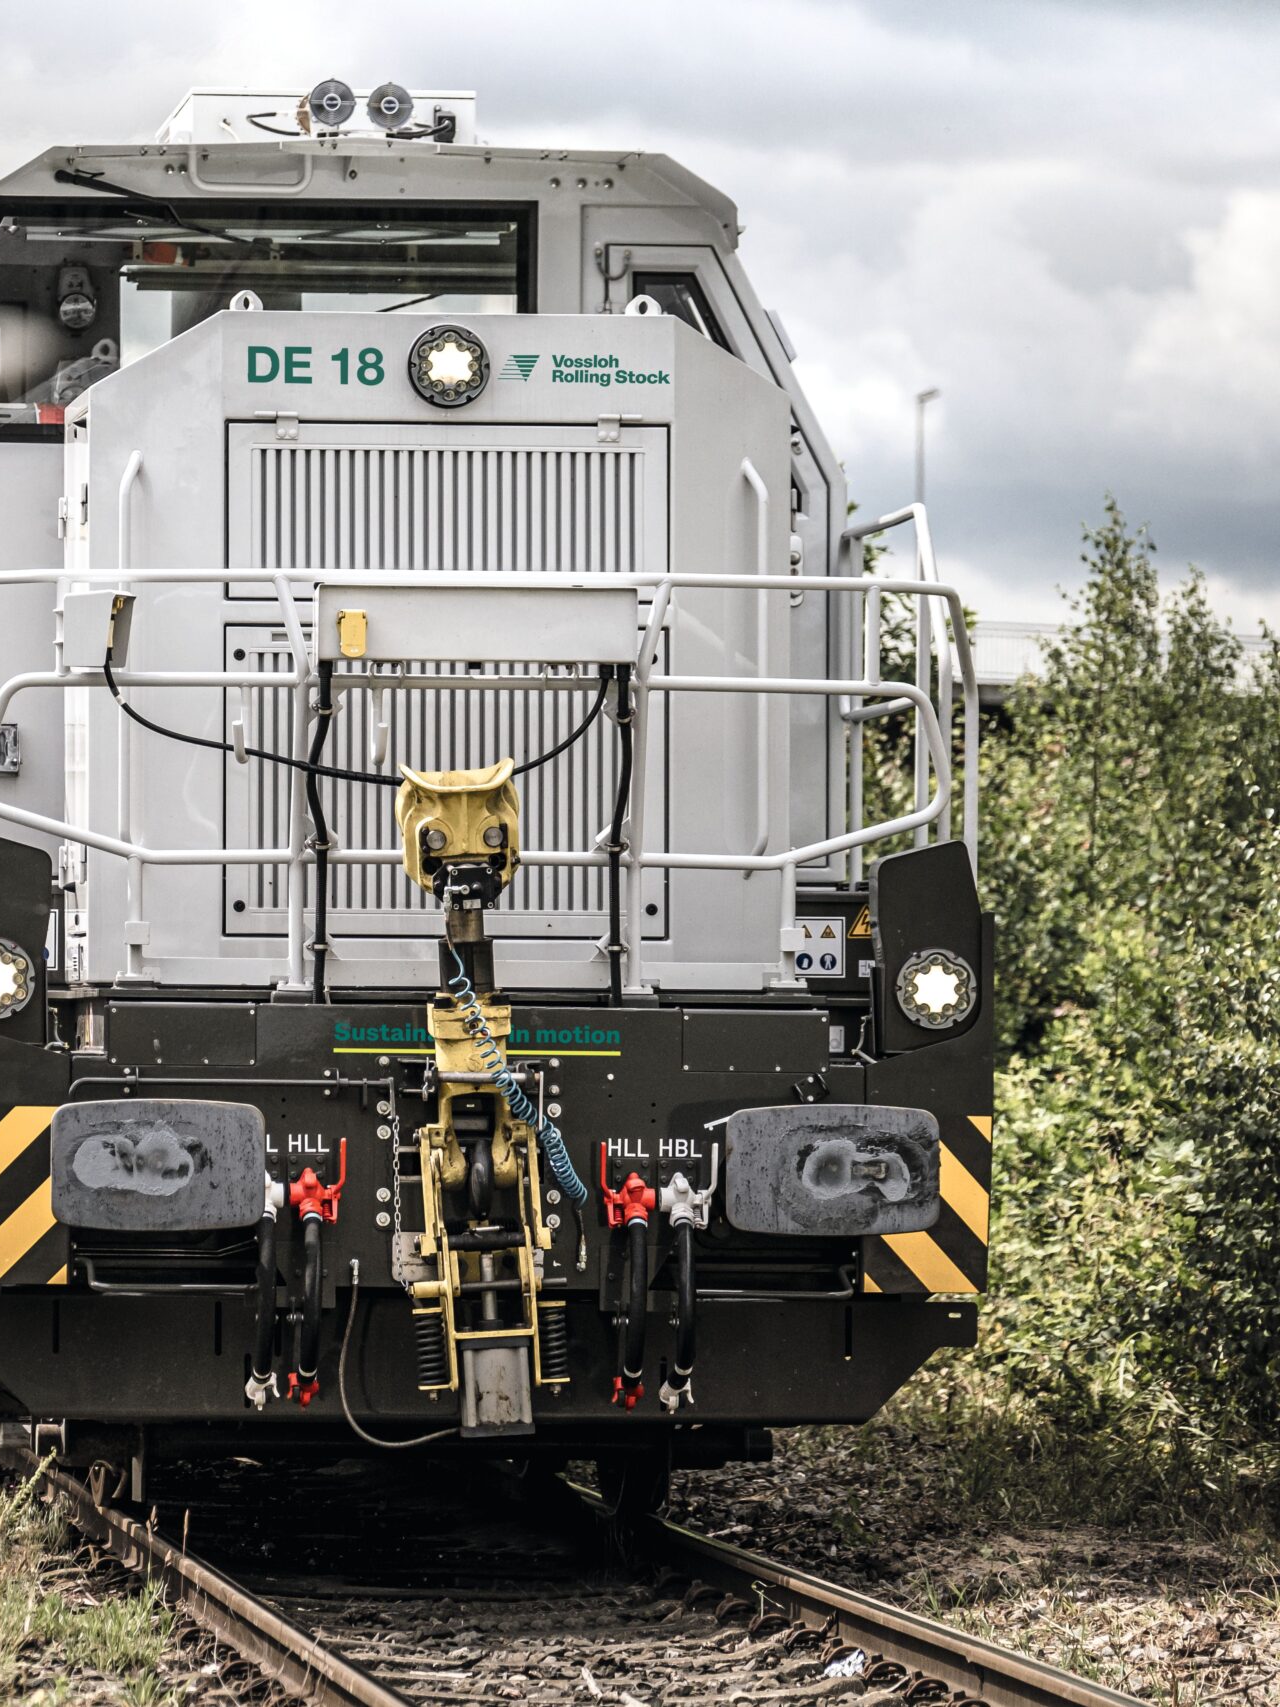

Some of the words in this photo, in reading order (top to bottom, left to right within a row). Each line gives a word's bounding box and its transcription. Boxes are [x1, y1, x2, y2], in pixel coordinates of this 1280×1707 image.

[247, 346, 313, 384] DE
[331, 347, 385, 386] 18
[552, 354, 619, 368] Vossloh
[552, 369, 611, 387] Rolling
[614, 370, 671, 384] Stock
[334, 1022, 434, 1043] Sustain
[535, 1024, 621, 1044] motion
[288, 1133, 330, 1153] HLL
[607, 1138, 650, 1158] HLL
[658, 1138, 703, 1158] HBL
